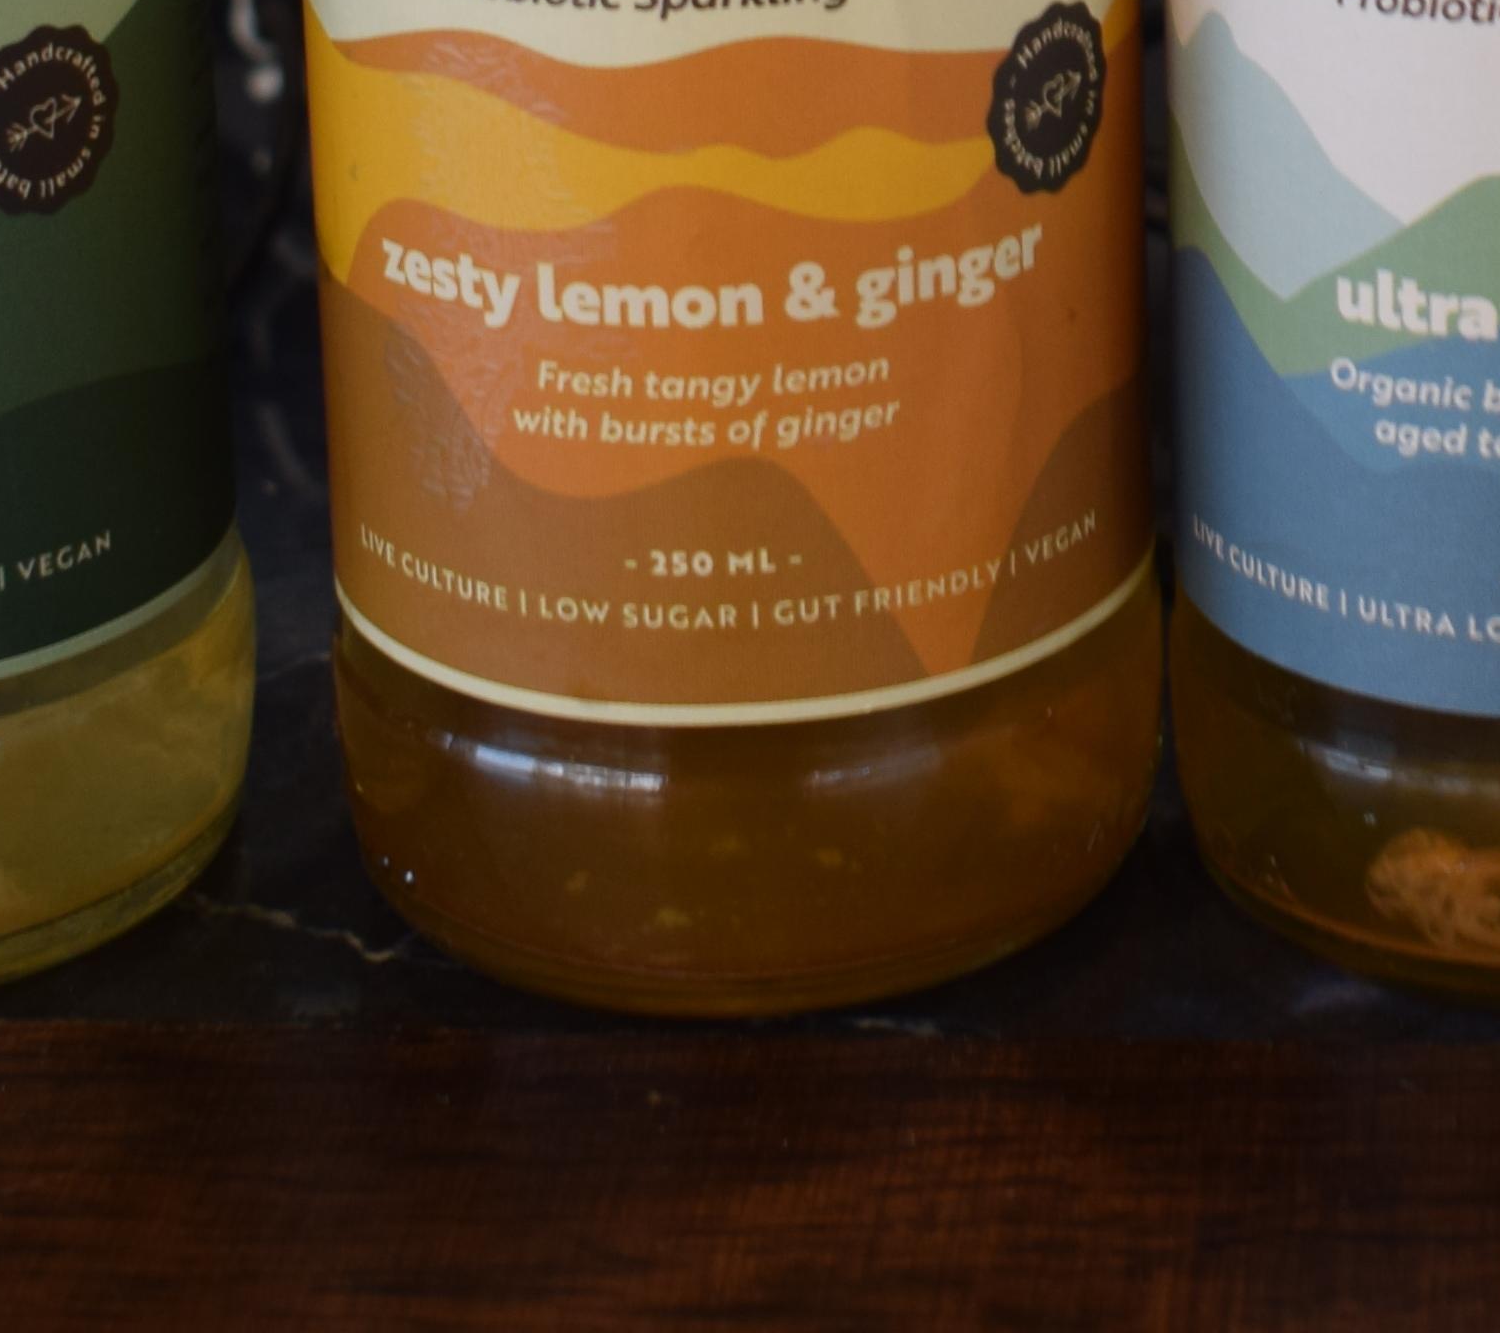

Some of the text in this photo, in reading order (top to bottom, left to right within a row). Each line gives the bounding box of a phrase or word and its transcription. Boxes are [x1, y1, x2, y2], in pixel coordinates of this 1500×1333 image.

[383, 224, 1044, 327] zesty lemon & ginger
[1336, 268, 1499, 343] ultra
[537, 356, 889, 406] Fresh tangy lemon
[1331, 358, 1471, 409] Organic
[513, 399, 899, 450] with bursts of ginger
[1376, 418, 1468, 460] aged
[651, 550, 777, 576] 250 ML
[402, 553, 508, 612] CULTURE
[540, 592, 610, 624] LOW
[622, 601, 738, 629] SUGAR
[774, 596, 840, 625] GUT
[854, 561, 1001, 618] FRIENDLY
[1229, 546, 1329, 611] CULTURE
[1359, 596, 1454, 637] ULTRA
